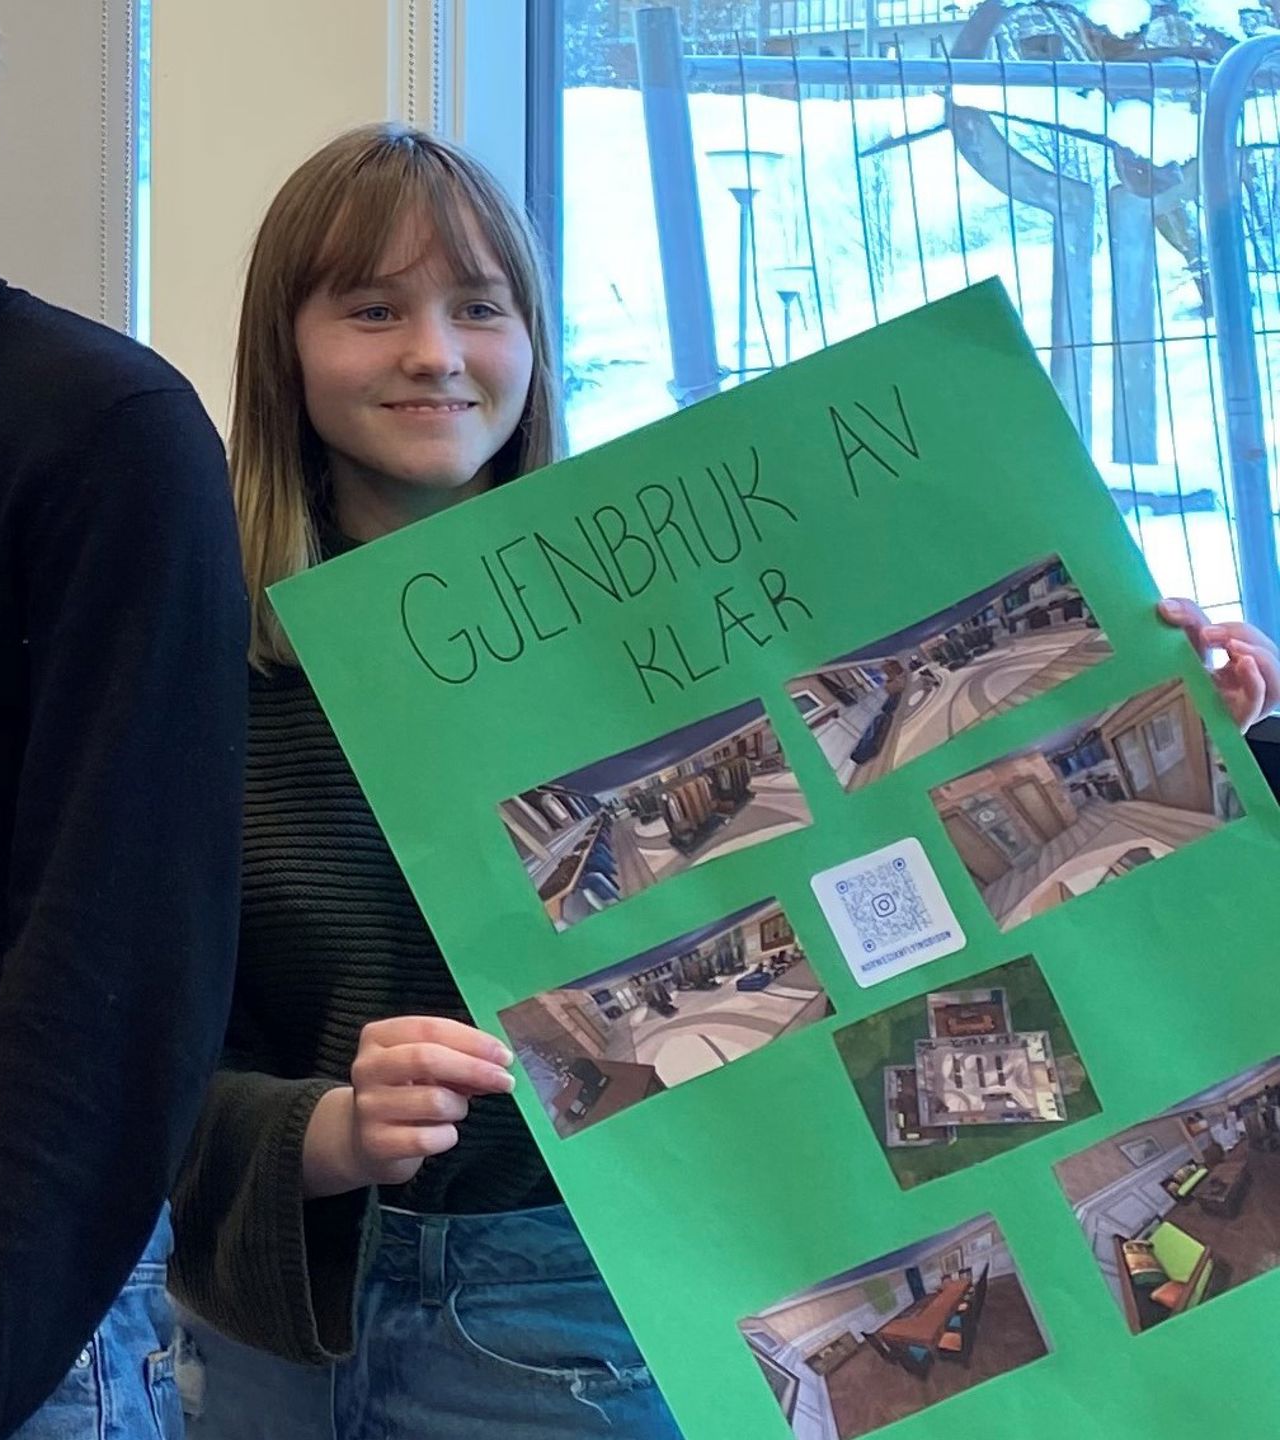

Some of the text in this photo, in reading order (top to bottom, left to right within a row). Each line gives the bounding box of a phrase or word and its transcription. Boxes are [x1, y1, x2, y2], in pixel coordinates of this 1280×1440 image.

[400, 384, 920, 684] GJENBRUK AV
[622, 568, 813, 704] KLÆR
